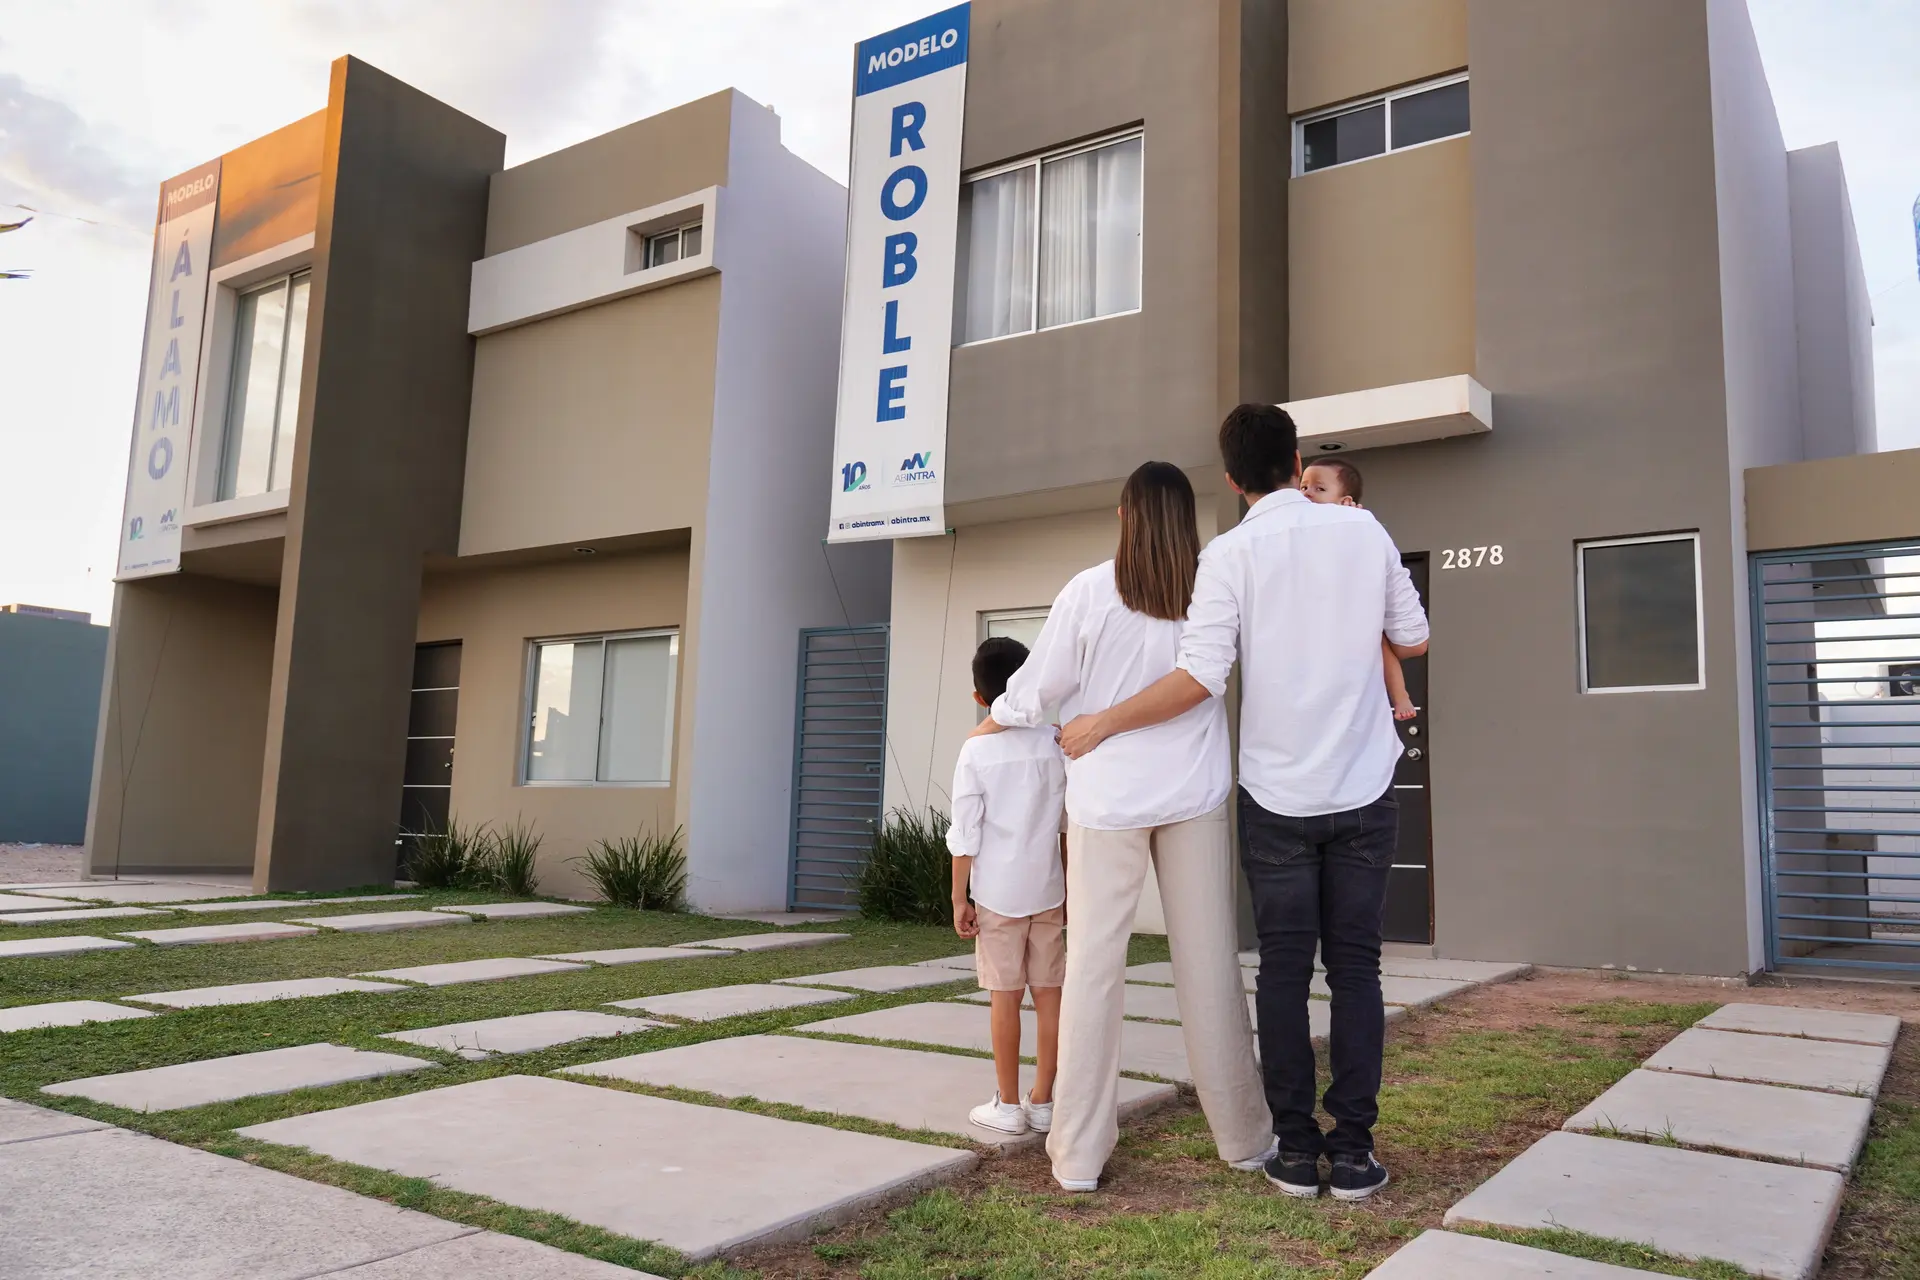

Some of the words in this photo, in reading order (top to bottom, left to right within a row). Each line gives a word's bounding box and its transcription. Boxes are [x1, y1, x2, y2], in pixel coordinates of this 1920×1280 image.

[868, 28, 958, 74] MODELO
[167, 174, 214, 206] MODELO
[876, 101, 928, 423] ROBLE
[148, 228, 192, 480] ÁLAMO
[842, 461, 866, 492] 10
[894, 470, 935, 483] ABINTRA
[852, 519, 885, 529] abintramx
[891, 515, 931, 525] abintra.mx
[1441, 545, 1504, 569] 2878
